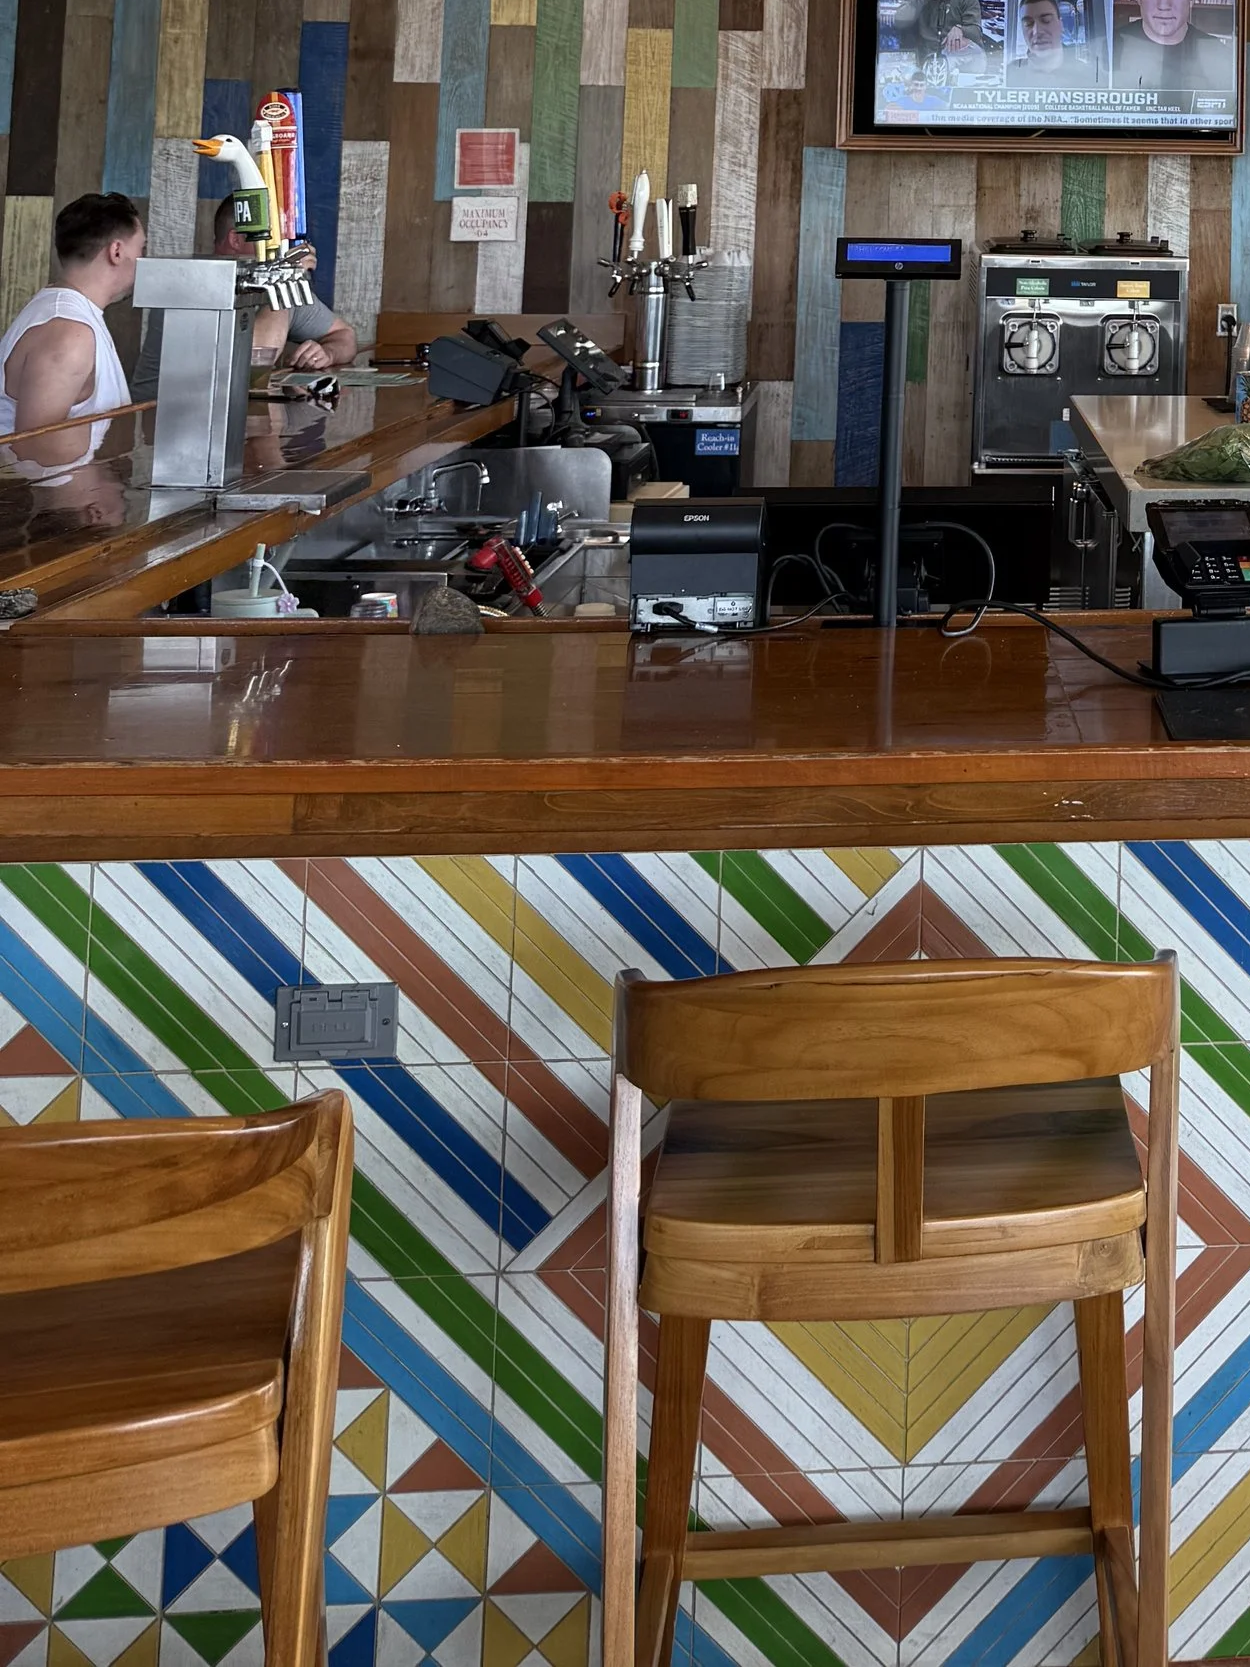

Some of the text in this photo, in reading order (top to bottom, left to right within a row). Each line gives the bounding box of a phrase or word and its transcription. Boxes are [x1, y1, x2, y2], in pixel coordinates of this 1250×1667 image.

[973, 90, 1158, 105] TYLER HANSBROUGH
[1196, 98, 1226, 109] ESPN
[931, 114, 946, 122] the
[948, 114, 974, 122] media
[977, 115, 1015, 124] coverage
[1017, 114, 1026, 122] of
[1028, 115, 1042, 123] the
[1123, 116, 1130, 124] it
[1163, 117, 1178, 125] that
[1180, 117, 1188, 125] in
[1190, 117, 1212, 125] other
[462, 209, 506, 219] MAXIMUM
[459, 219, 509, 229] OCCUPANCY
[701, 433, 735, 442] Reach-in
[698, 443, 723, 451] Cooler
[684, 514, 710, 522] EPSON
